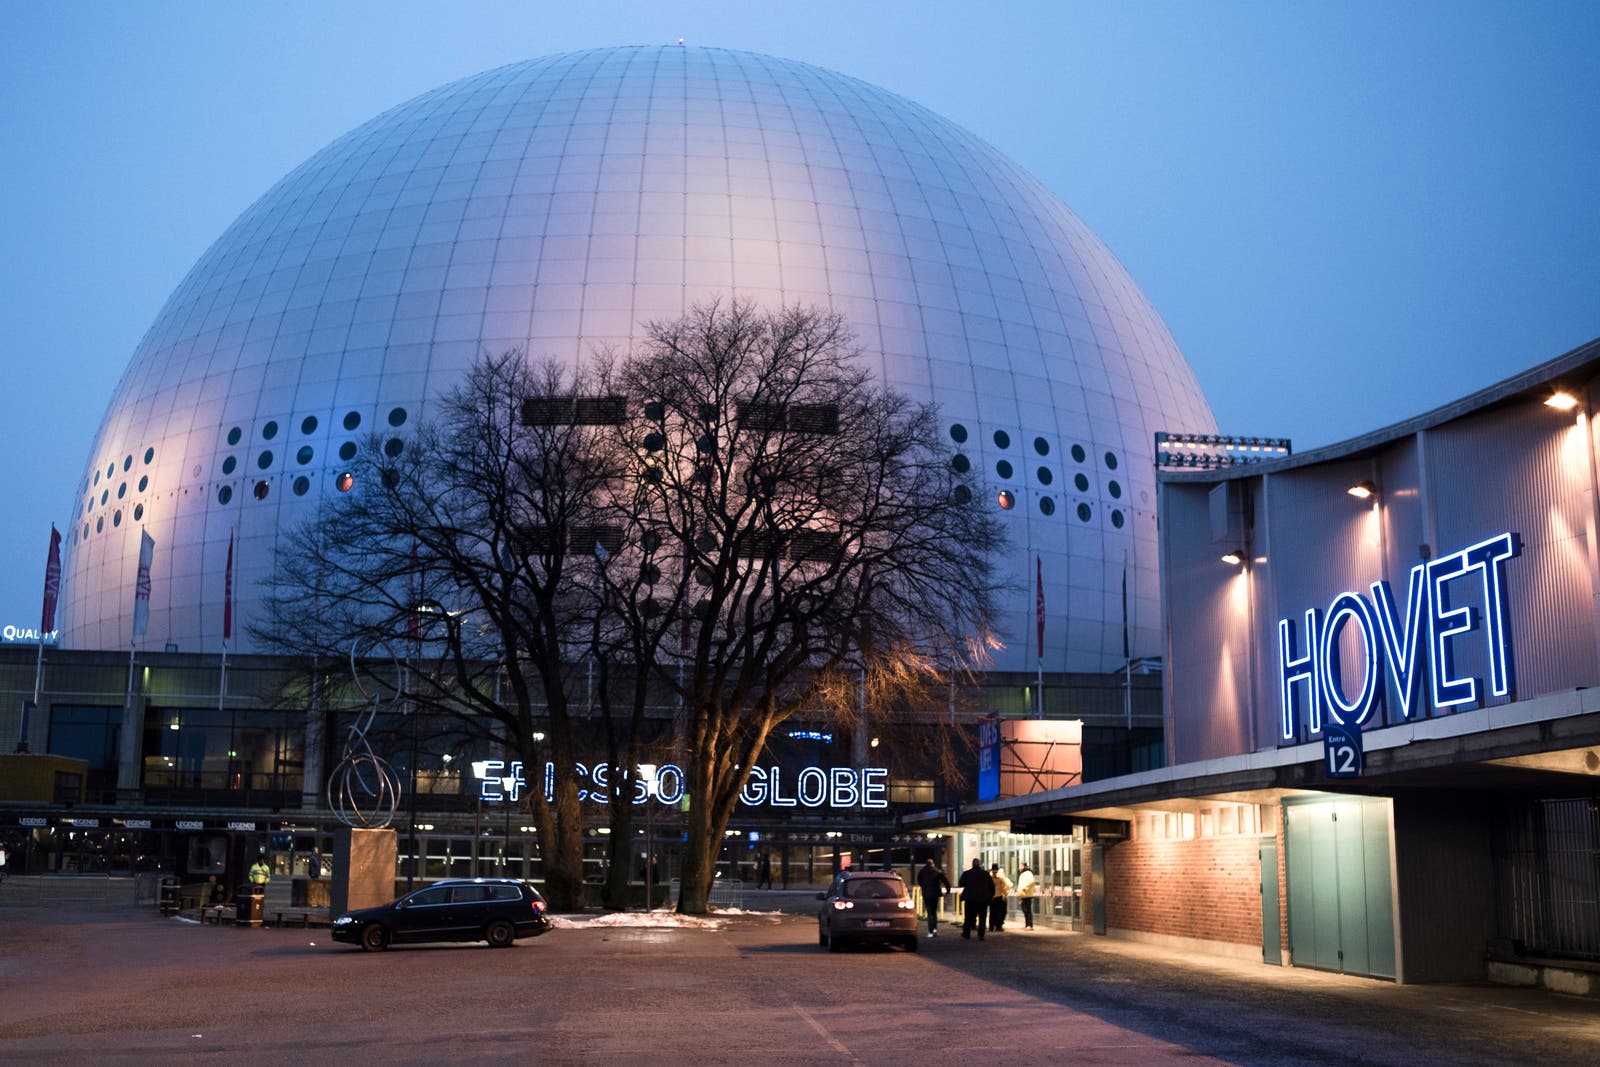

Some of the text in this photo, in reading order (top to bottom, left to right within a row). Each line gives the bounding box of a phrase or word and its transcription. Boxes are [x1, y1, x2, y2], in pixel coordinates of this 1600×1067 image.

[136, 566, 152, 600] LIVE
[3, 624, 59, 641] QUALY
[1279, 532, 1516, 740] HOVET
[1328, 735, 1346, 743] Entré
[1329, 745, 1356, 773] 12
[479, 761, 888, 808] ERISSO GLOBE
[18, 816, 47, 826] LEGENDS
[123, 818, 151, 828] LEGENDS
[175, 819, 204, 829] LEGENDS
[947, 810, 957, 824] 11
[227, 821, 256, 831] LEGENDS
